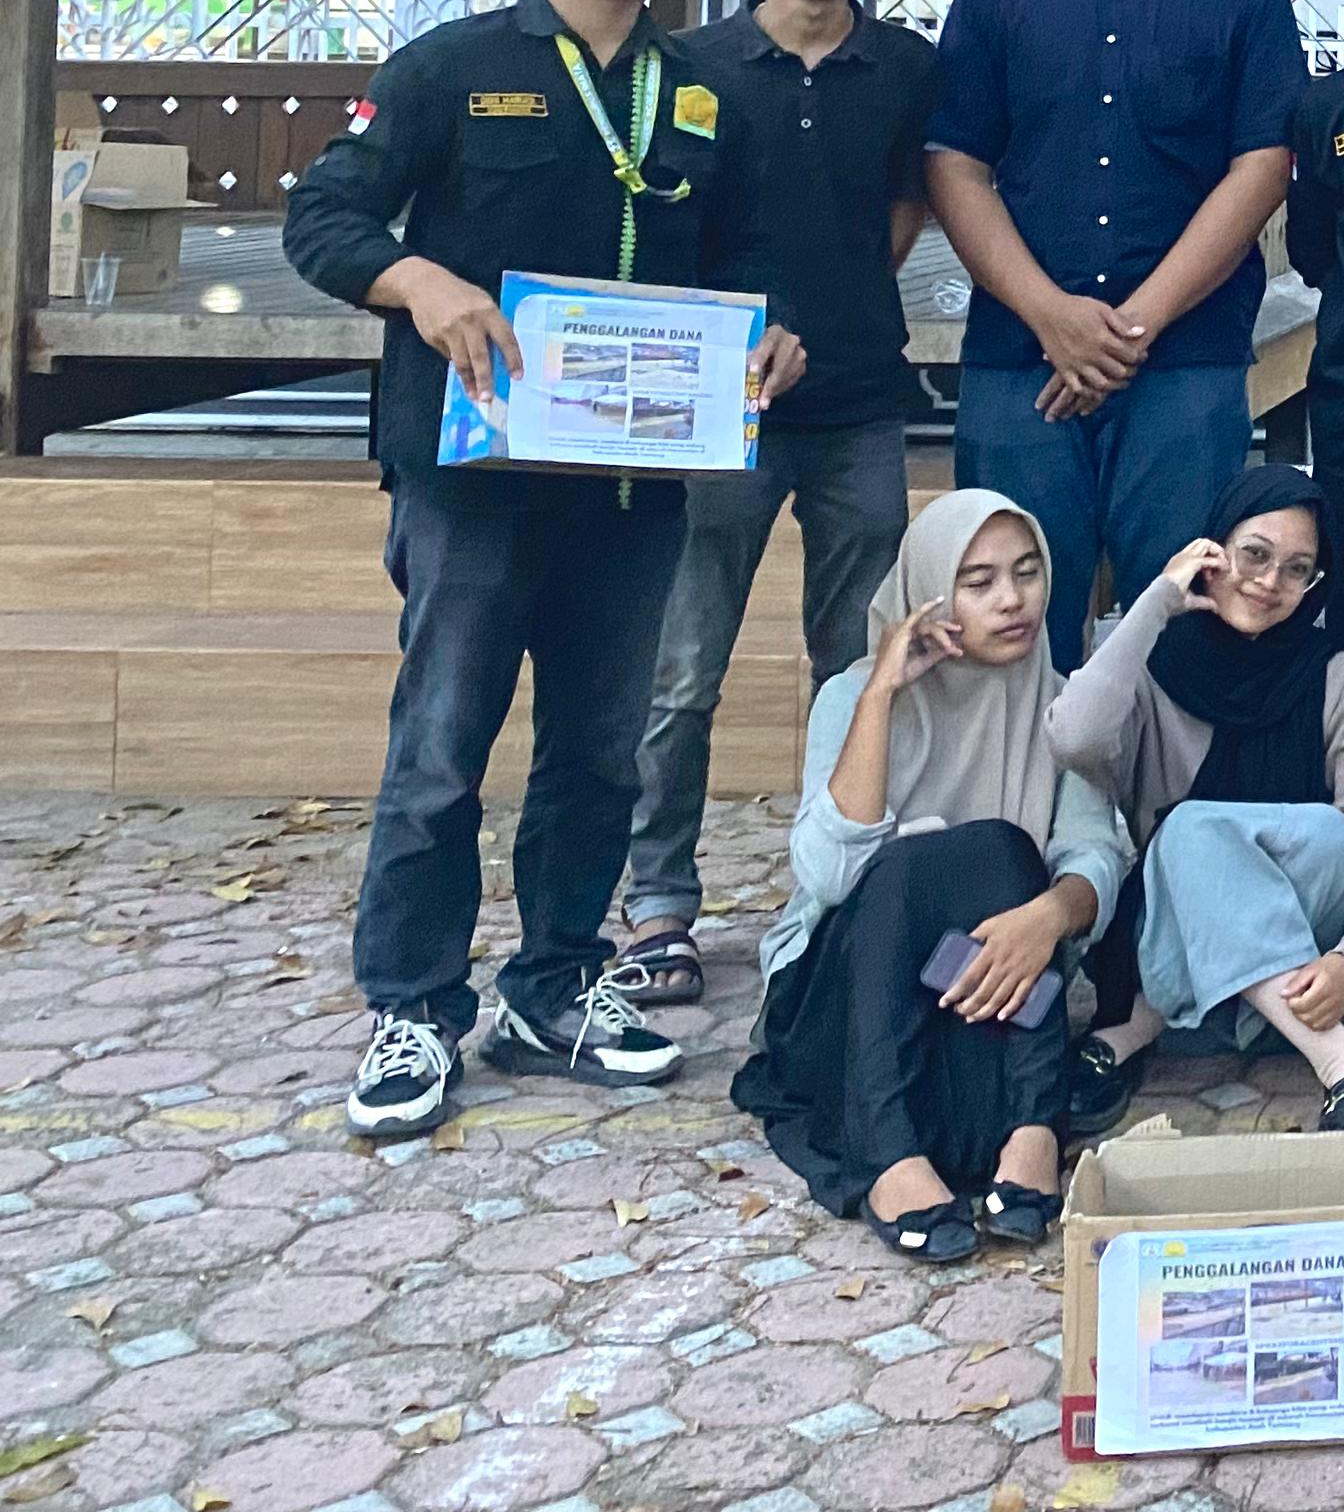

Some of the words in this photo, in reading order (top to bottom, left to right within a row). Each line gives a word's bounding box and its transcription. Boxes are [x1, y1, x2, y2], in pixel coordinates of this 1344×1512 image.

[563, 322, 666, 339] PENGGALANGAN
[669, 329, 703, 341] DANA
[1162, 1259, 1296, 1280] PENGGALANGAN
